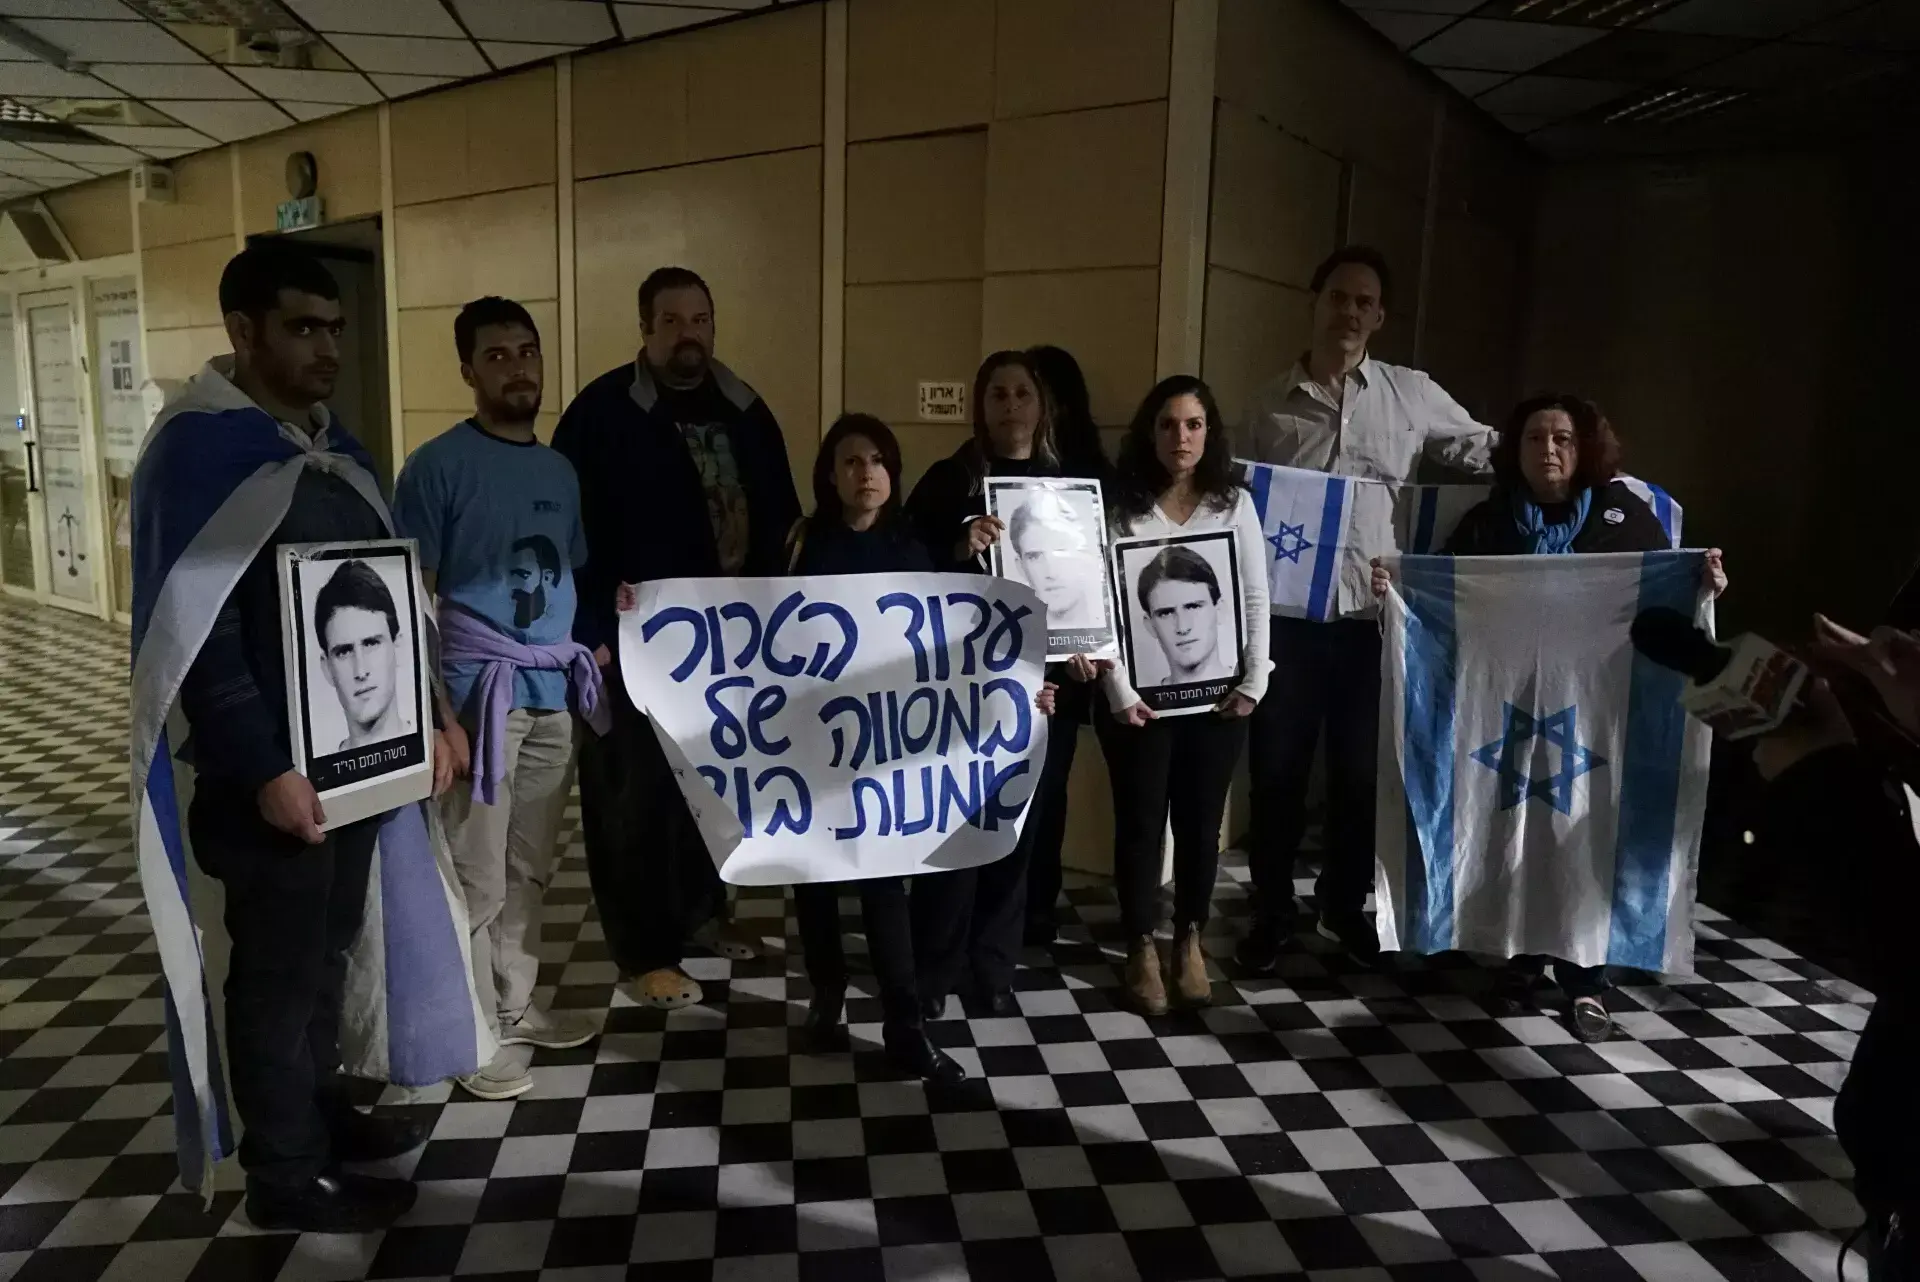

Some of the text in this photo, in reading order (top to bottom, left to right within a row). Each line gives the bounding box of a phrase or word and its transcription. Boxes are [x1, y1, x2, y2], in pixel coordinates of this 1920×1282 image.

[930, 387, 953, 400] ארון
[1048, 635, 1095, 646] משה תמם
[1179, 688, 1203, 700] תמם
[1205, 684, 1228, 697] משה
[704, 675, 1032, 772] במסווה של
[384, 745, 407, 762] משה
[358, 752, 382, 769] תמם
